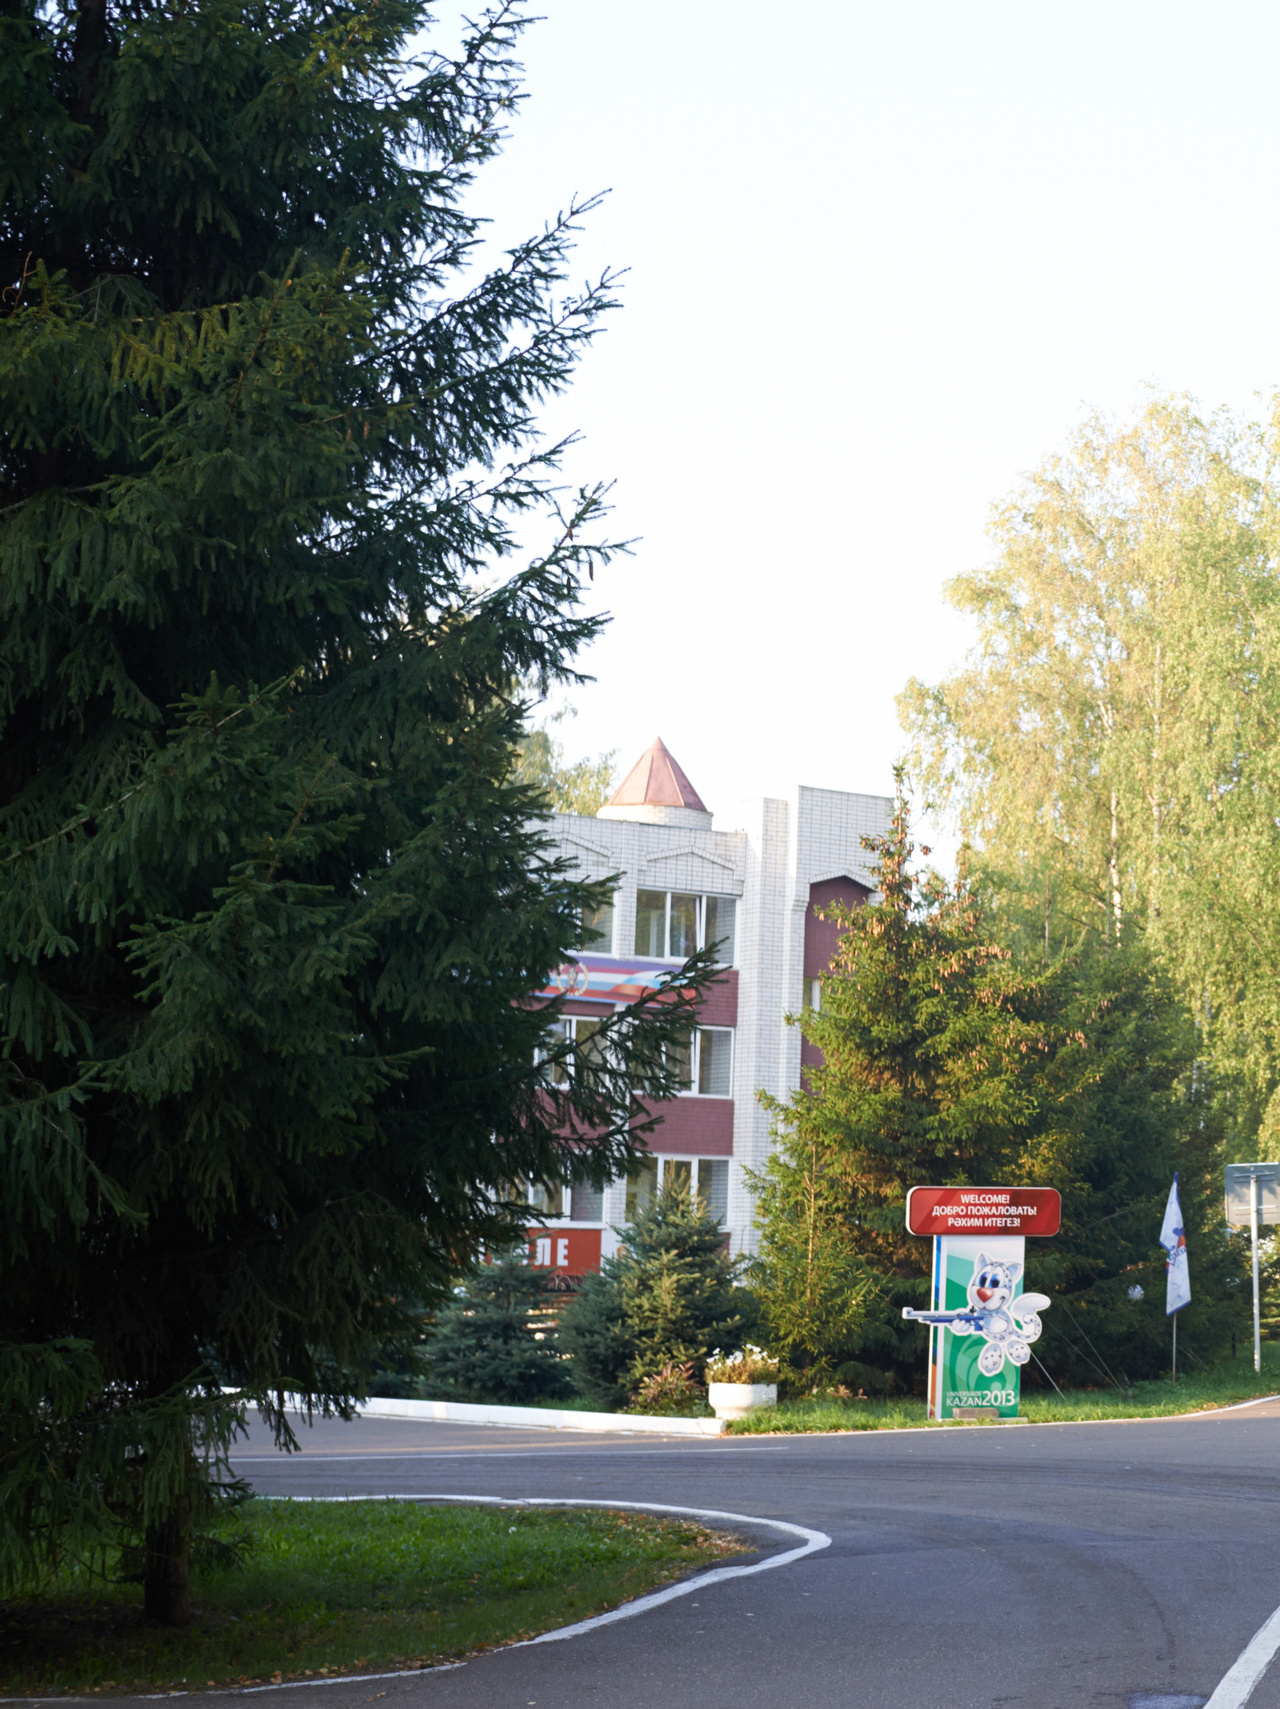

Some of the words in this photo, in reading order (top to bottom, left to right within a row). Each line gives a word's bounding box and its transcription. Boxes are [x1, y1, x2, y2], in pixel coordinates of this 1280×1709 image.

[960, 1194, 1010, 1204] WELCOME!
[932, 1205, 967, 1217] ДОБРО
[967, 1205, 1037, 1216] ПОЖАЛОВАТЬ!
[948, 1217, 983, 1227] РӘХИМ
[984, 1217, 1021, 1227] ИТЕГЕЗ!
[946, 1397, 982, 1406] KAZAN
[982, 1390, 1015, 1406] 2013
